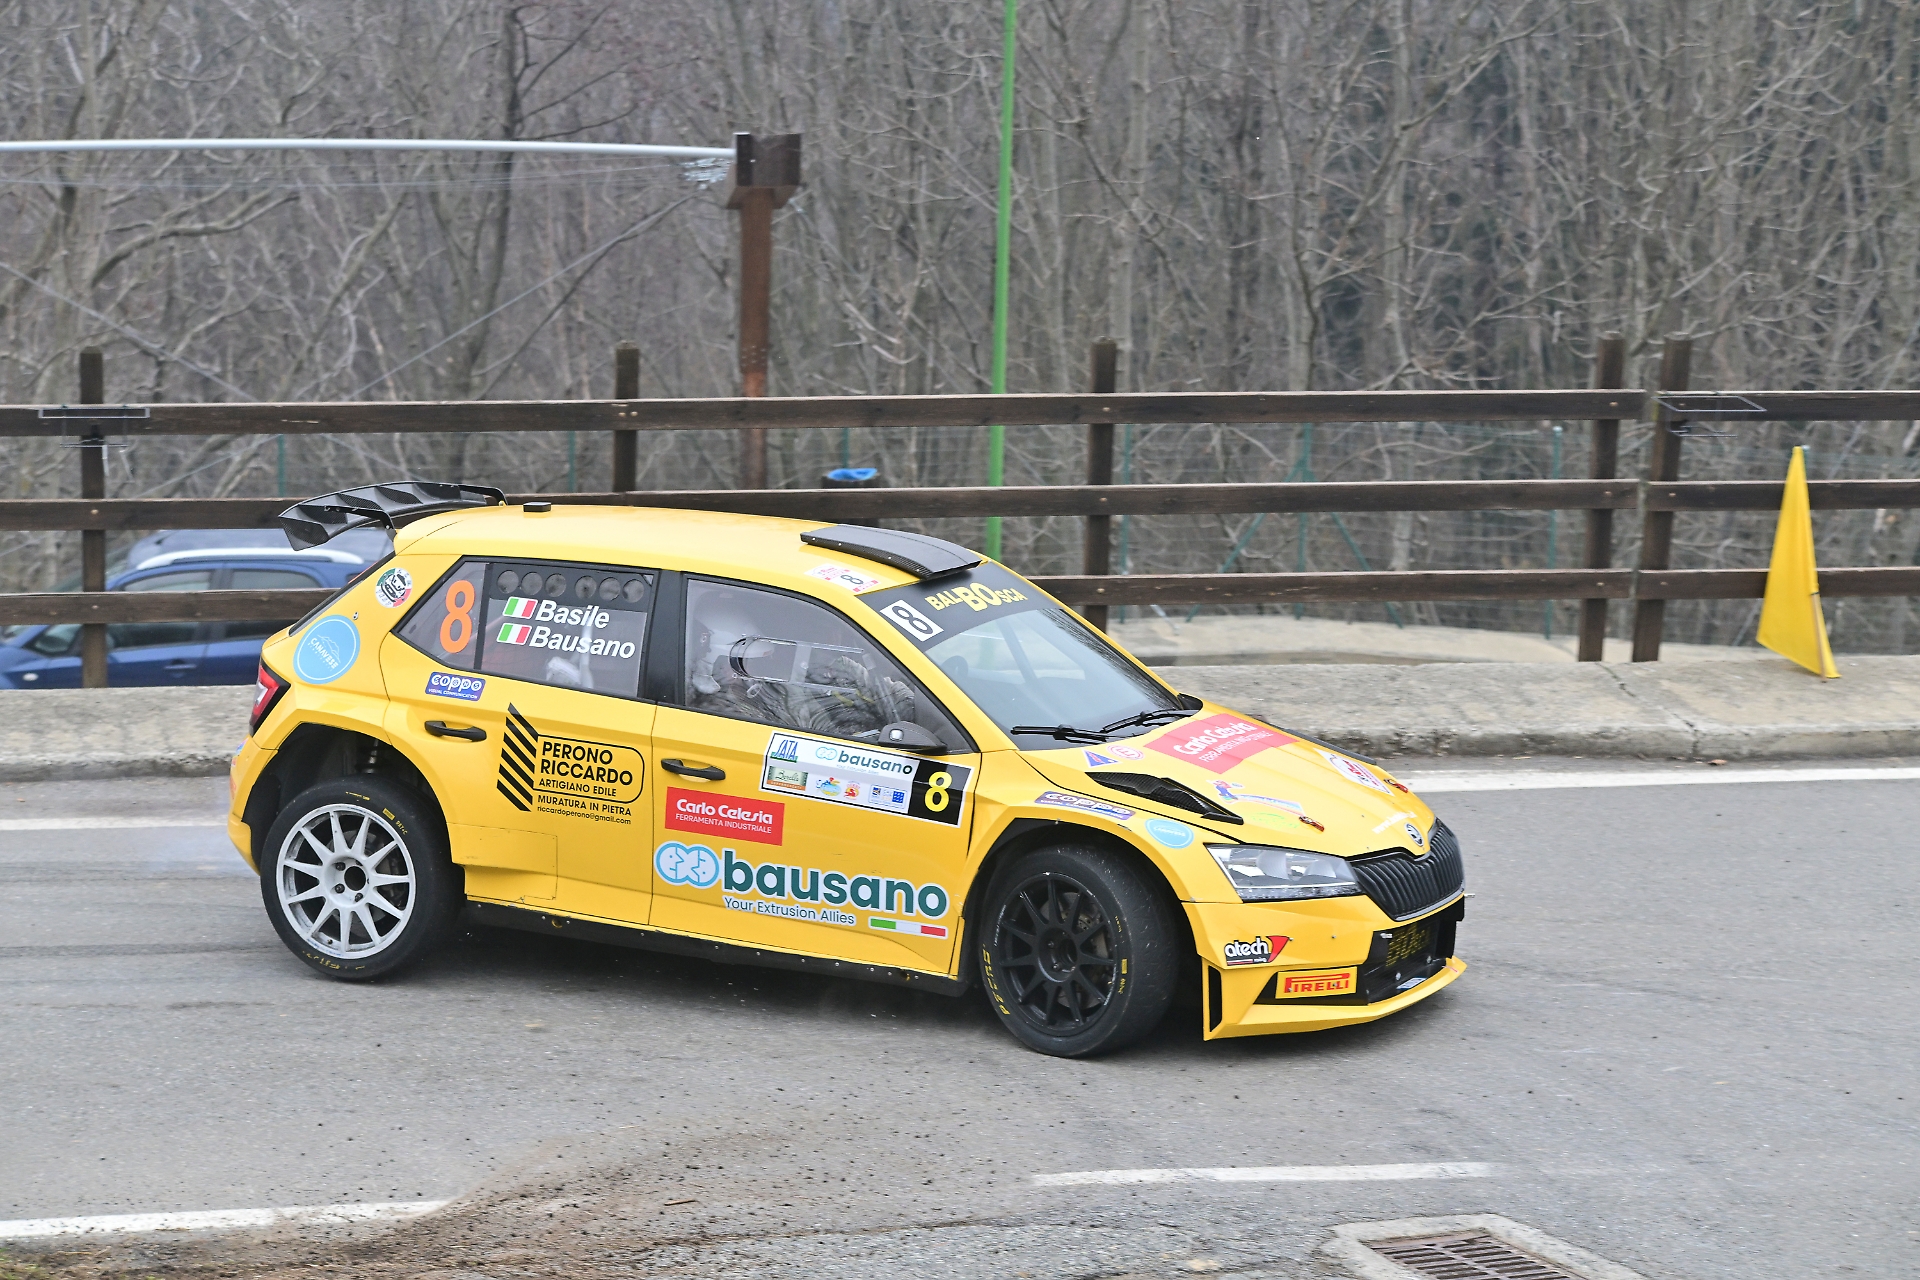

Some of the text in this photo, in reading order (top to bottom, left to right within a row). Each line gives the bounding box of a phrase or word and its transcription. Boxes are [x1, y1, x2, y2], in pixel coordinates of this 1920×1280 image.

[840, 574, 864, 584] 8
[924, 582, 1028, 612] BALBOSCA
[440, 579, 475, 654] 8
[535, 600, 610, 628] Basile
[892, 605, 934, 634] 8
[310, 638, 338, 669] CANAVESE
[529, 626, 636, 658] Bausano
[432, 674, 482, 692] coppo
[542, 741, 613, 764] PERONO
[838, 750, 913, 774] bausano
[540, 759, 633, 786] RICCARDO
[539, 778, 616, 796] ARTIGIANO EDILE
[924, 771, 952, 812] 8
[537, 806, 632, 824] riccardoperono@gmail.com
[538, 795, 632, 816] MURATURA IN PIETRA
[676, 799, 773, 824] Carlo Celesia
[676, 814, 772, 834] FERRAMENTA INDUSTRIALE
[724, 850, 947, 917] bausano
[725, 897, 855, 925] Your Extrusion Allies
[1225, 937, 1268, 957] atech
[1284, 973, 1350, 993] PIRELLI
